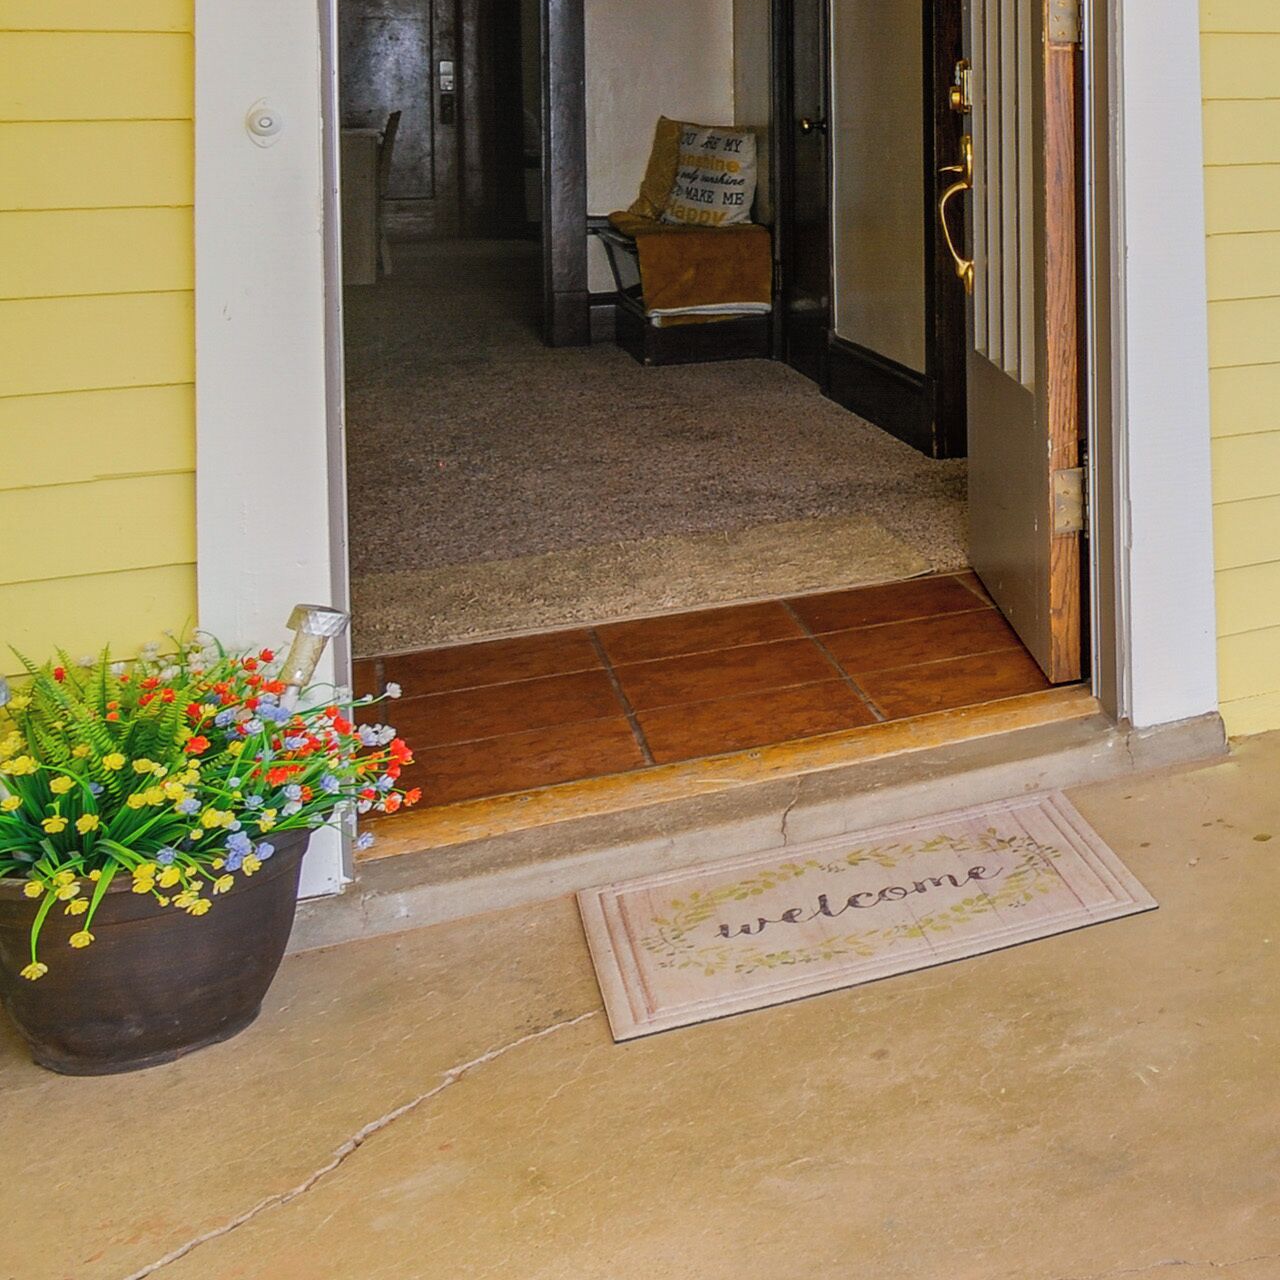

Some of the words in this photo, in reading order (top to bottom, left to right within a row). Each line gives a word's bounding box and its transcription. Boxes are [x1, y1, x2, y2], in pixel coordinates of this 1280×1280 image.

[723, 138, 743, 153] MY
[701, 173, 746, 186] sunshine
[685, 186, 715, 204] MAKE
[722, 192, 745, 205] ME
[714, 865, 1003, 938] welcome
